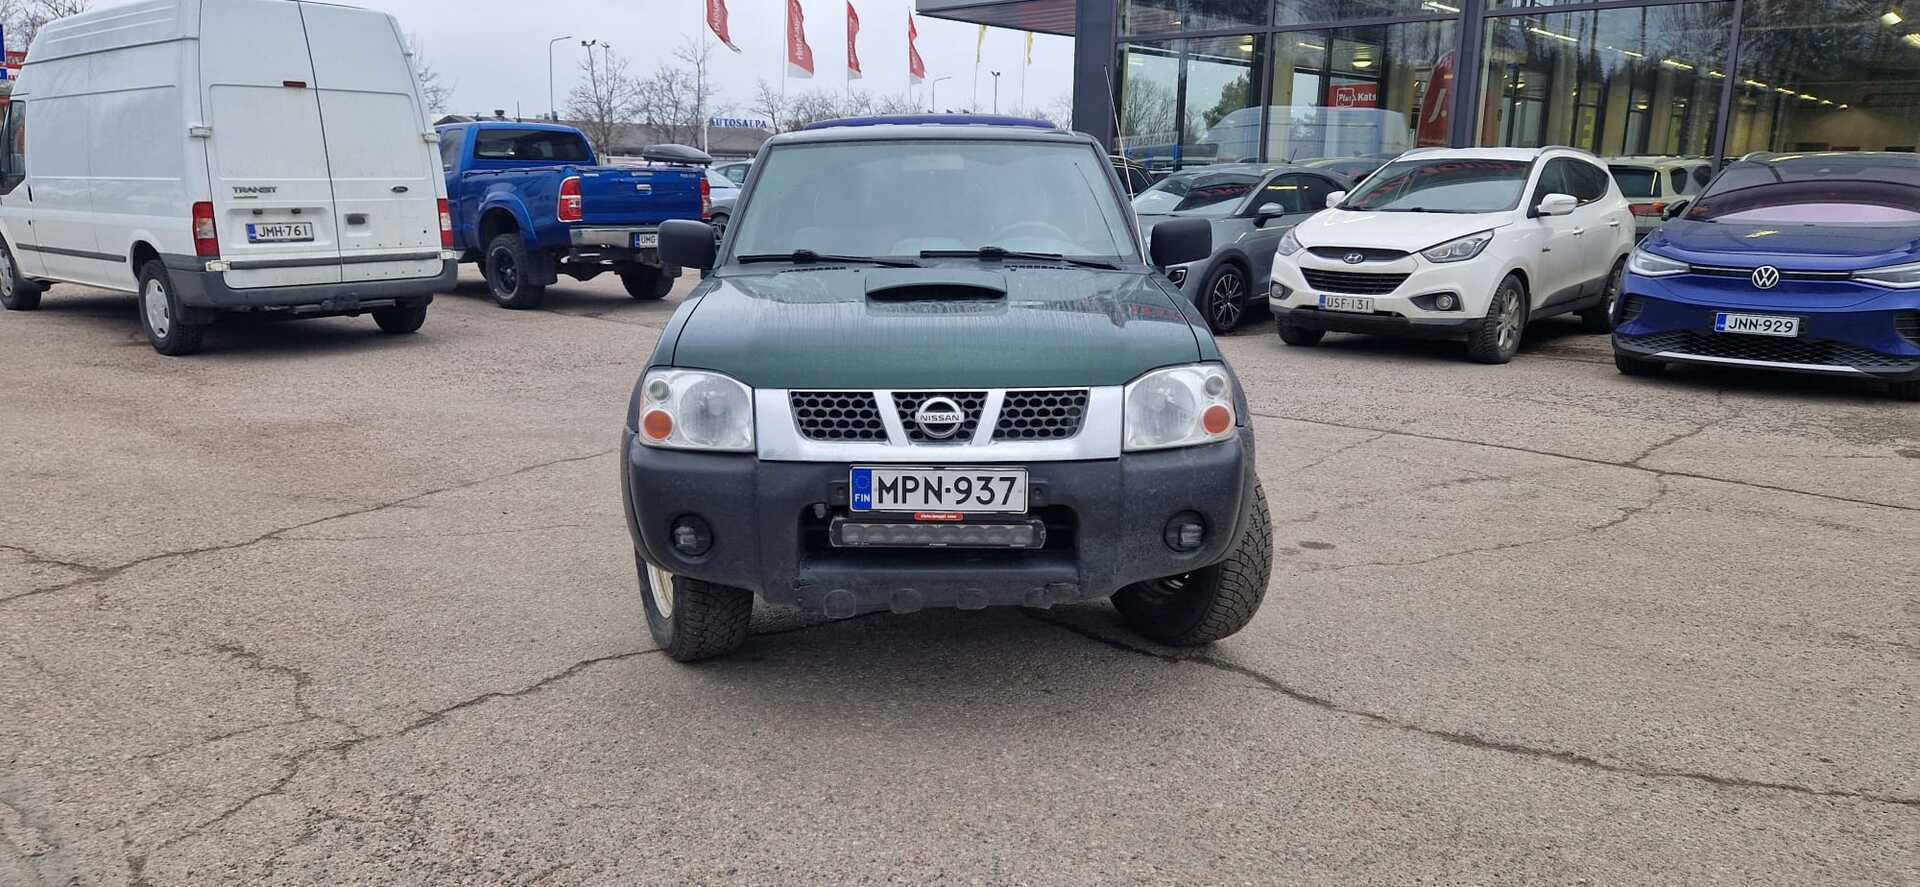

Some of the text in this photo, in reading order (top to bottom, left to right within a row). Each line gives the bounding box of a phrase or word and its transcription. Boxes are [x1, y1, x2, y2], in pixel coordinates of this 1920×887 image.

[709, 117, 767, 128] AUTOSALPA
[259, 225, 308, 237] JMH-761
[1327, 297, 1369, 310] USF-131
[1729, 317, 1793, 333] JNN-929
[855, 475, 1017, 505] FIN MPN-937
